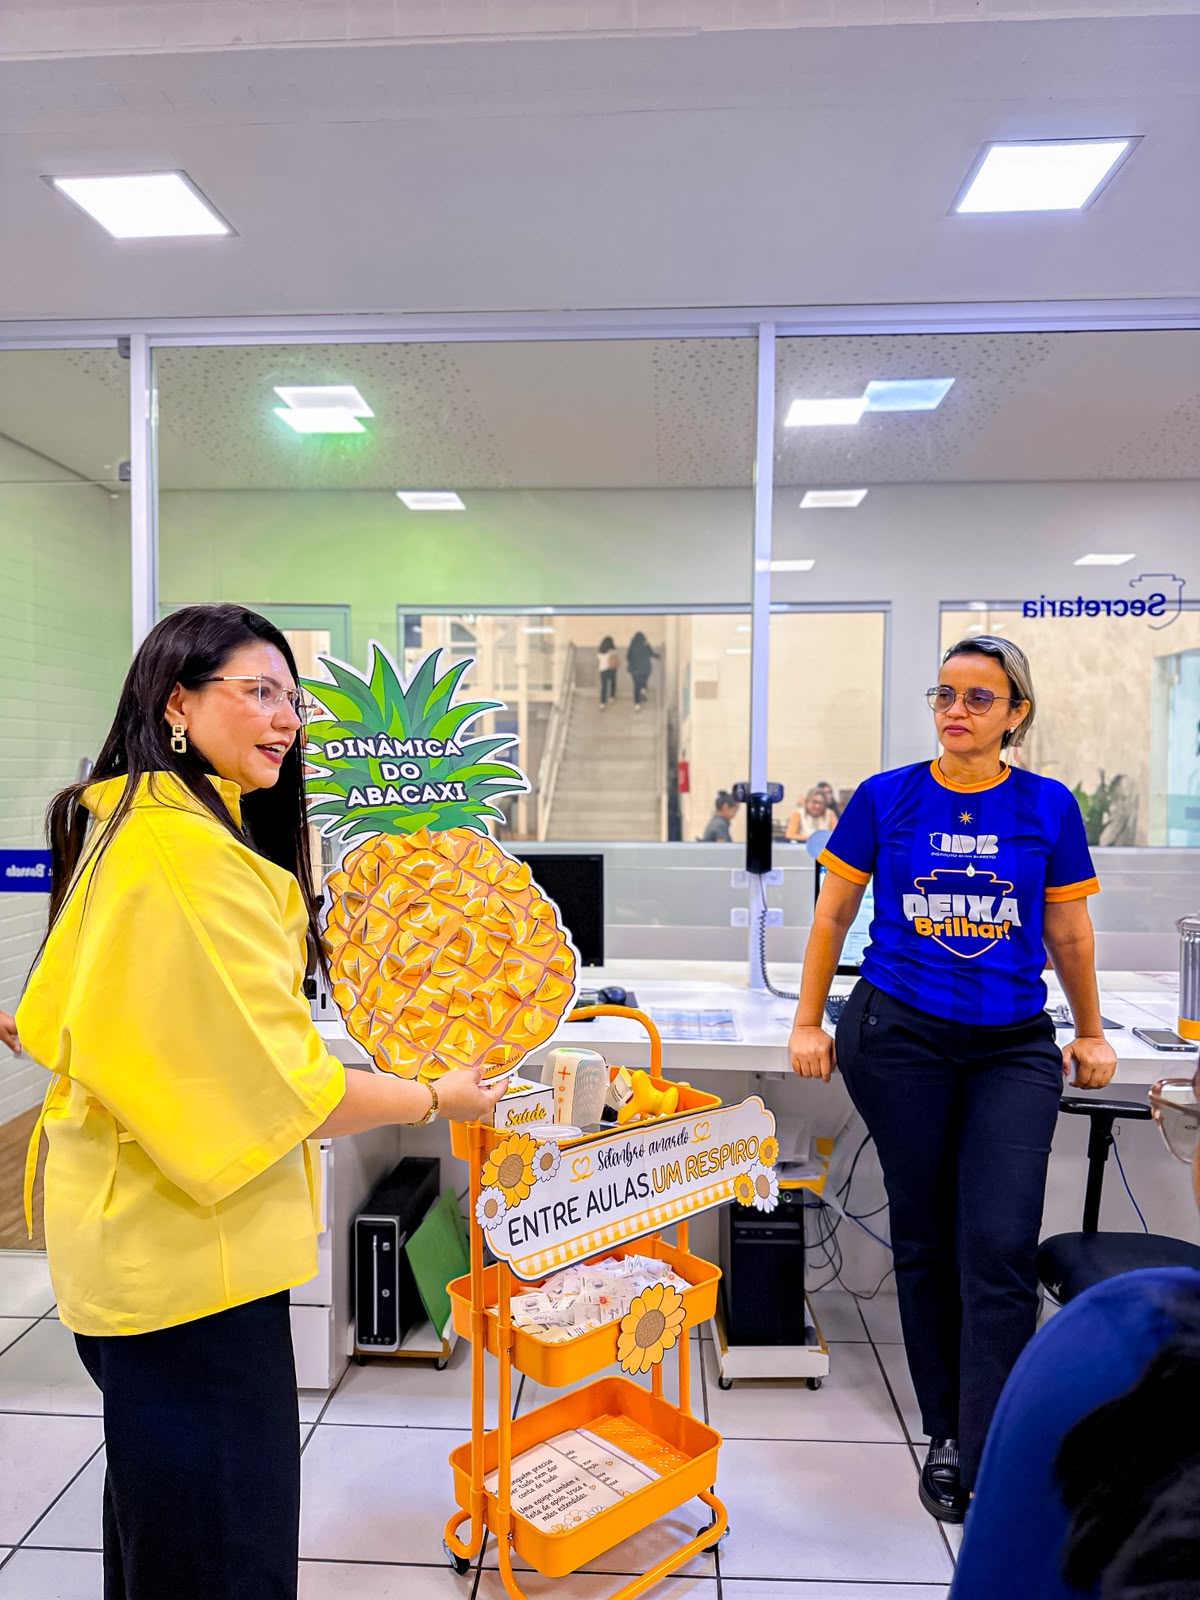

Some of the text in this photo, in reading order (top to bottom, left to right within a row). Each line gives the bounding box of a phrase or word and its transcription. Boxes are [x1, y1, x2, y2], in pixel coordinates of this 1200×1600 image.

[324, 732, 464, 760] DINÂMICA
[380, 762, 421, 781] DO
[346, 781, 469, 808] ABACAXI
[941, 833, 999, 855] IDB
[902, 893, 1022, 927] DEIXA
[914, 917, 1011, 941] Brilhar!
[508, 1196, 581, 1246] ENTRE
[652, 1160, 683, 1193] UM
[685, 1135, 759, 1182] RESPIRO
[516, 1504, 534, 1515] Uma
[533, 1492, 553, 1507] equipe
[551, 1479, 576, 1494] também
[525, 1509, 542, 1520] feita
